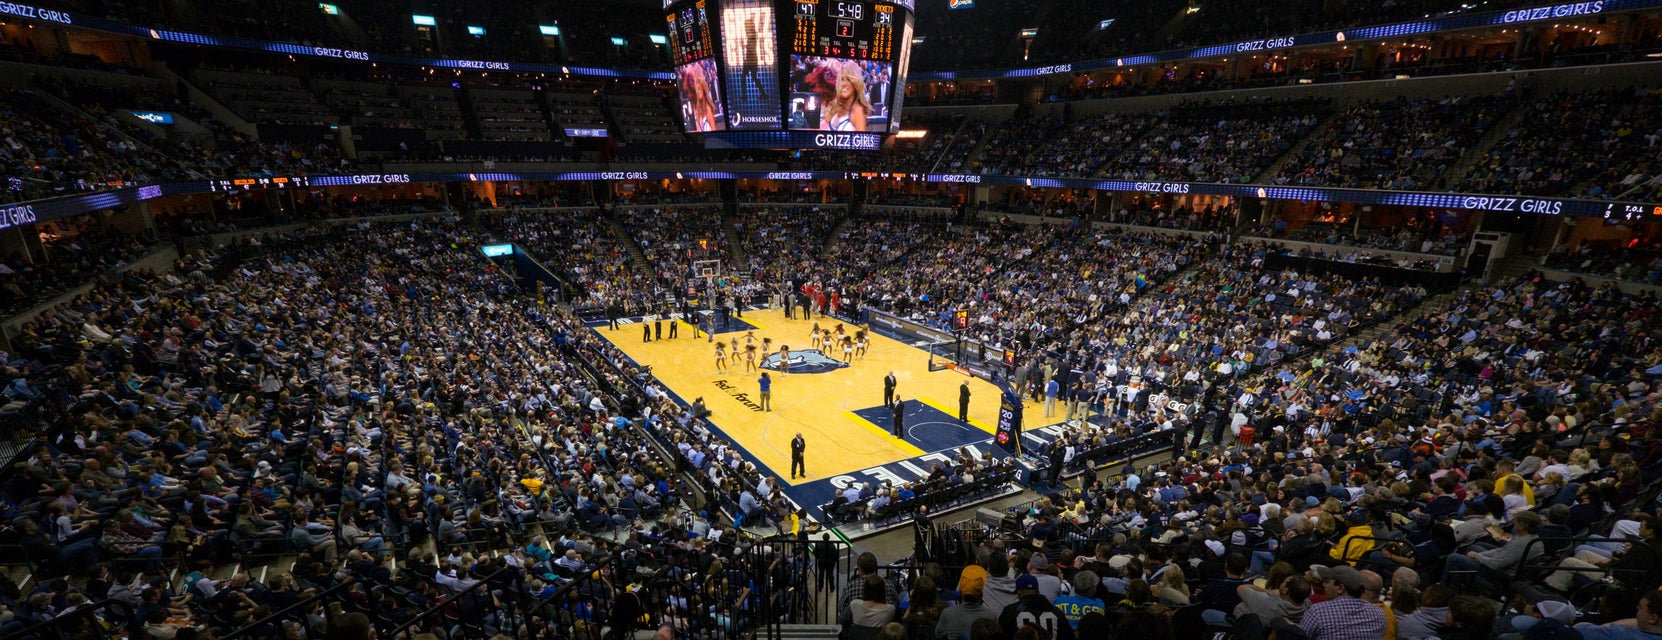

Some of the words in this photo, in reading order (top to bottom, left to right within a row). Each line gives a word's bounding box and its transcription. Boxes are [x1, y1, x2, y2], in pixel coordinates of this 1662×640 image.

[0, 1, 37, 18] GRIZZ
[38, 9, 72, 24] GIRLS
[801, 4, 813, 14] 47
[838, 2, 862, 19] 5:48
[1504, 6, 1552, 23] GRIZZ
[1555, 0, 1604, 17] GIRLS
[880, 12, 890, 23] 34
[842, 26, 848, 36] 2
[824, 46, 830, 54] 3
[1236, 40, 1265, 52] GRIZZ
[1266, 36, 1295, 49] GIRLS
[315, 47, 343, 58] GRIZZ
[344, 50, 369, 60] GIRLS
[726, 37, 775, 66] GILS
[459, 60, 485, 69] GRIZZ
[485, 61, 510, 70] GIRLS
[1036, 66, 1054, 76] GRIZZ
[1054, 63, 1072, 74] GIRLS
[815, 133, 851, 147] GRIZZ
[852, 134, 875, 148] GIRLS
[353, 174, 383, 184] GRIZZ
[383, 174, 410, 184] GIRLS
[601, 172, 625, 180] GRIZZ
[626, 172, 648, 180] GIRLS
[768, 172, 790, 180] GRIZZ
[791, 172, 813, 180] GIRLS
[942, 174, 965, 183] GRIZZ
[965, 175, 981, 184] GIRLS
[1135, 182, 1162, 192] GRIZZ
[1162, 182, 1189, 194] GIRLS
[1464, 196, 1517, 211] GRIZZ
[1520, 200, 1562, 215] GIRLS
[8, 205, 36, 226] GIRLS
[1071, 604, 1080, 615] &
